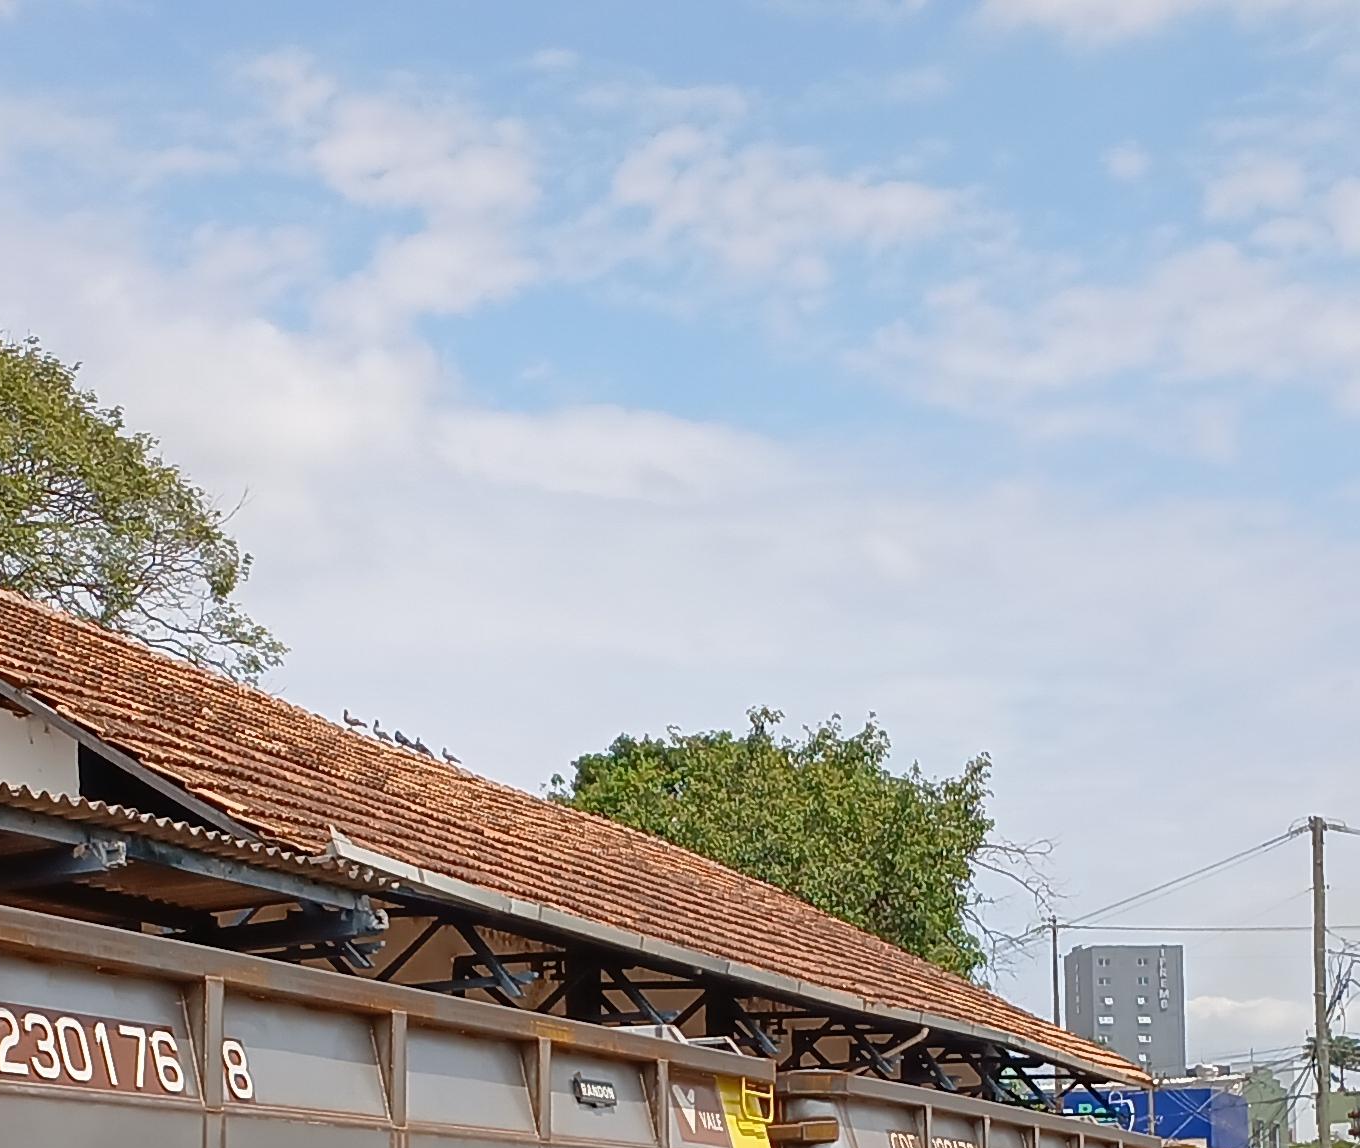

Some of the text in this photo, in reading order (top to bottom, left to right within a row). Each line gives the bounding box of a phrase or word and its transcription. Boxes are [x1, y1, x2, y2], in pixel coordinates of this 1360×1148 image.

[223, 1041, 253, 1098] 8
[580, 1083, 615, 1100] RANDON
[698, 1111, 723, 1132] VALE
